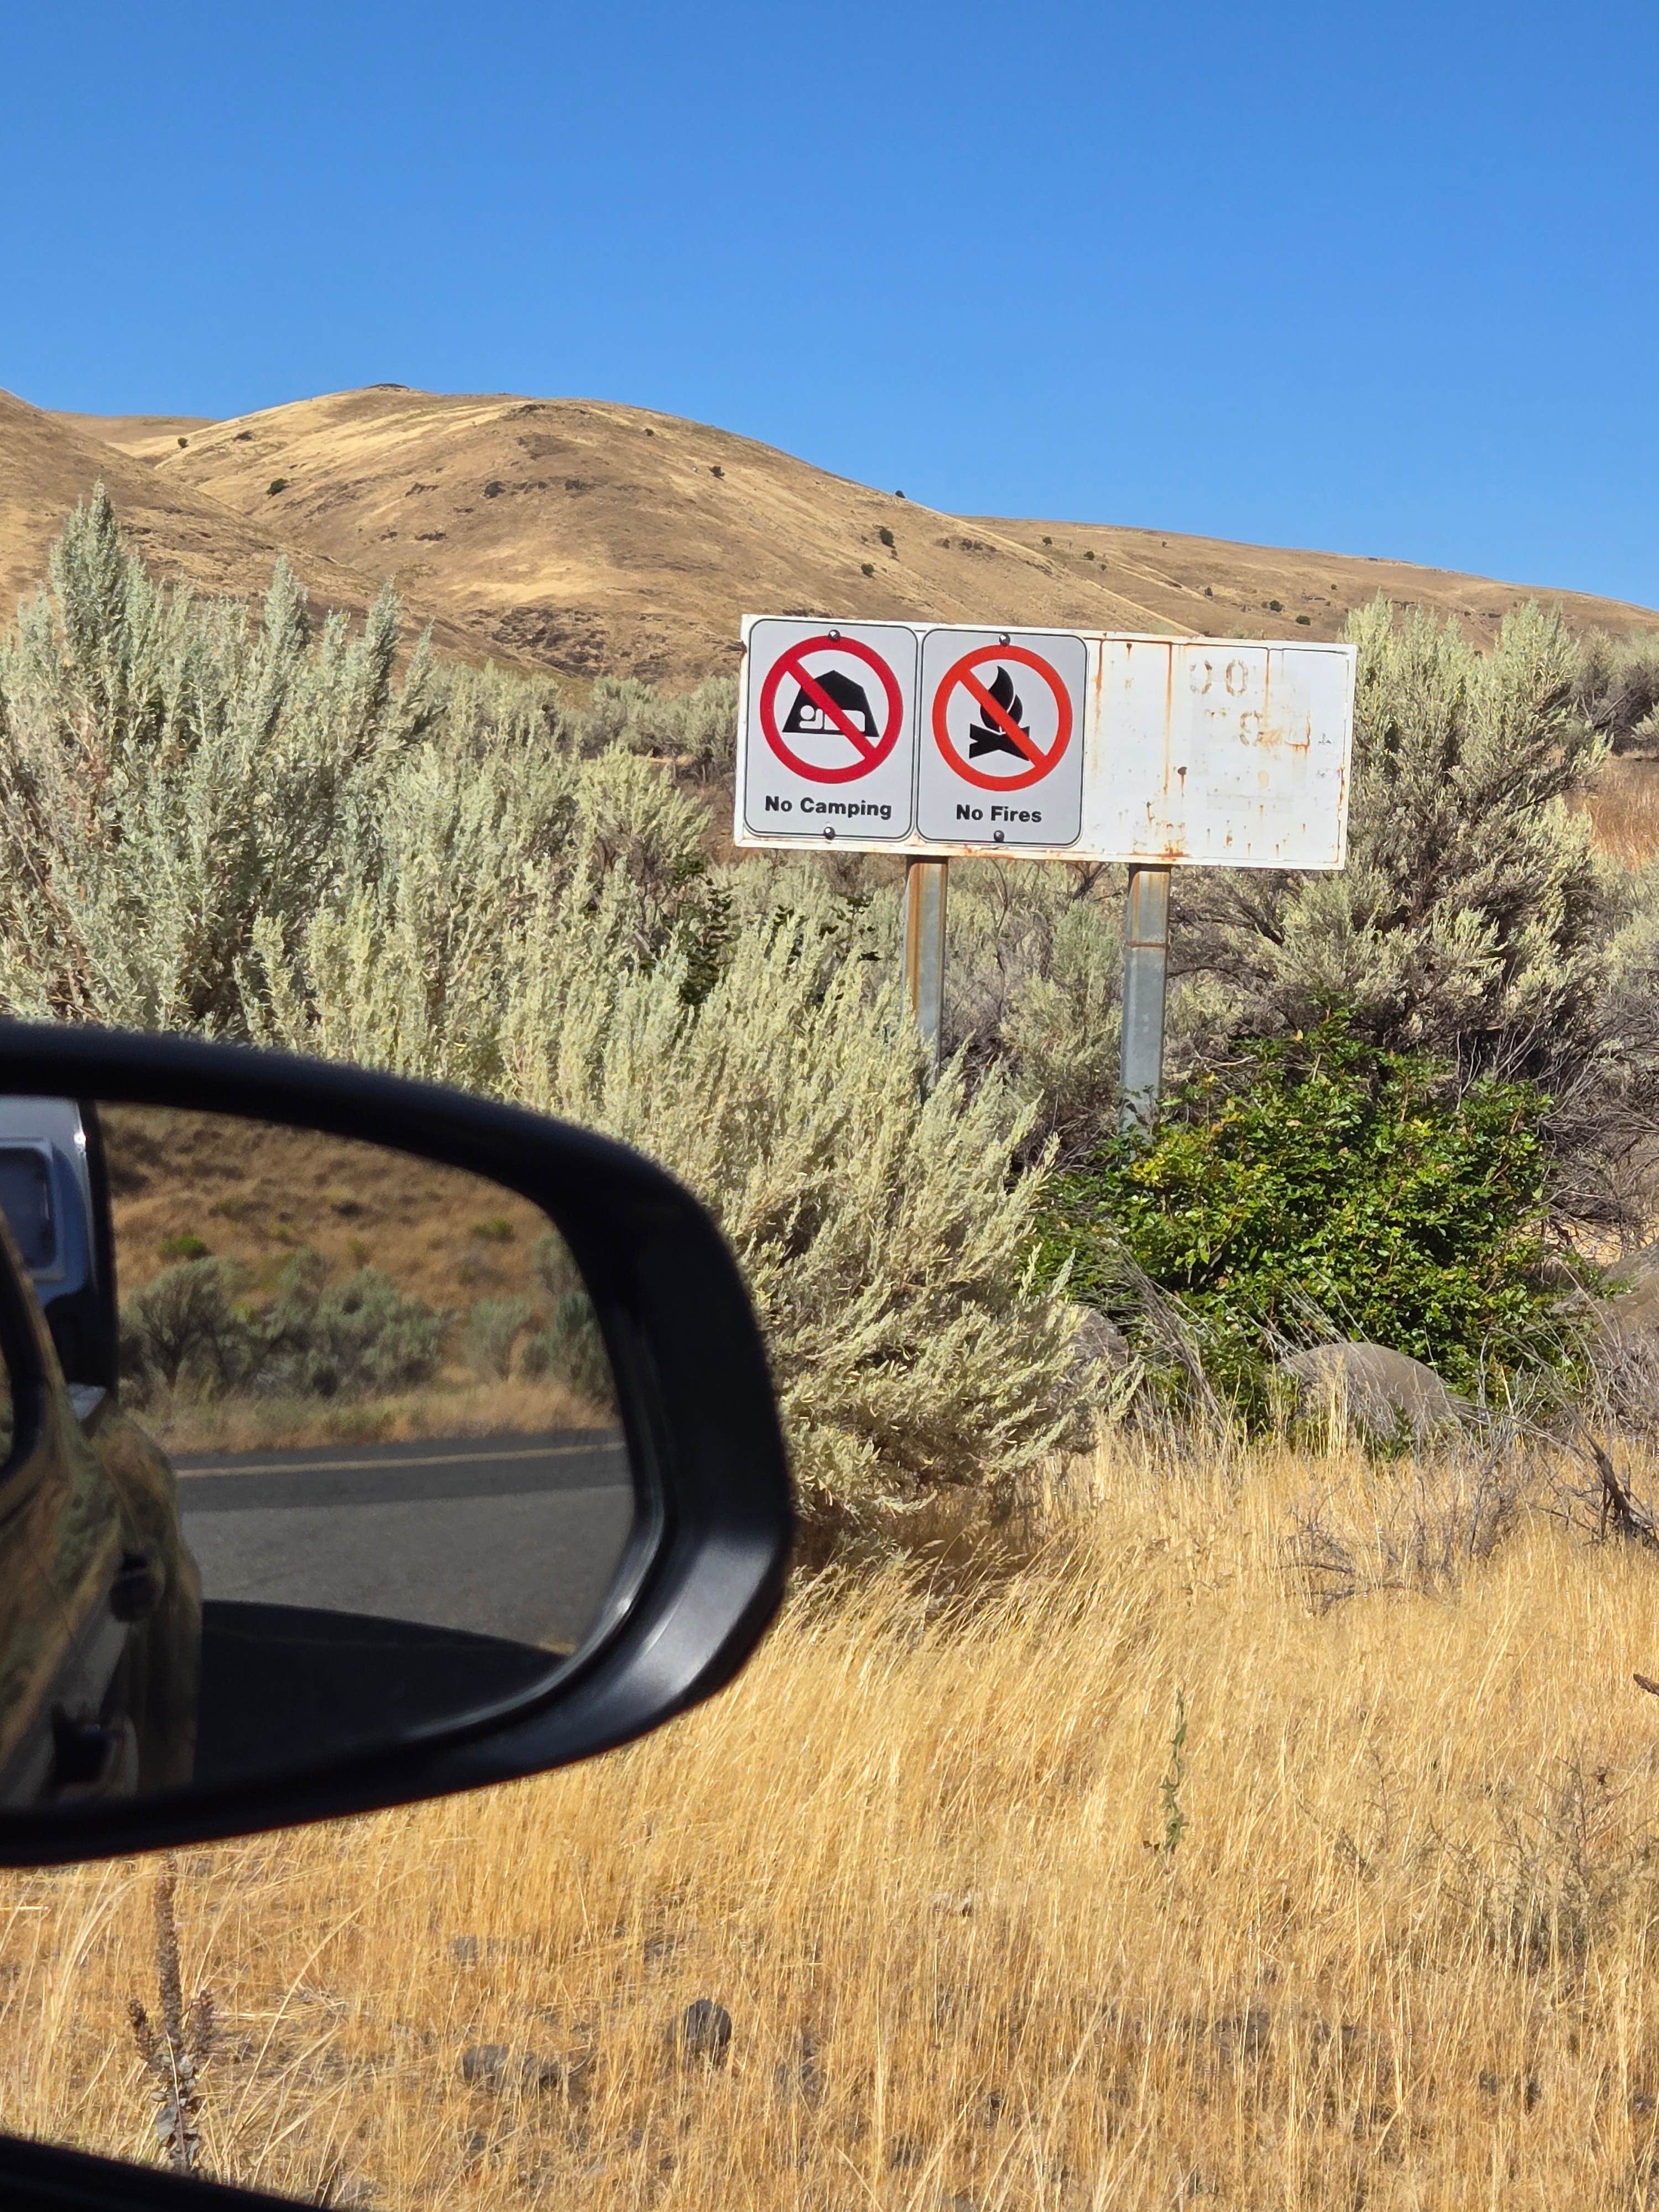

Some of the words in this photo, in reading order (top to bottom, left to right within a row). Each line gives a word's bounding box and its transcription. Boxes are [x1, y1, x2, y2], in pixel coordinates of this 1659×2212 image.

[765, 795, 792, 812] No
[800, 797, 891, 820] Camping
[956, 804, 983, 821] No
[990, 805, 1042, 823] Fires
